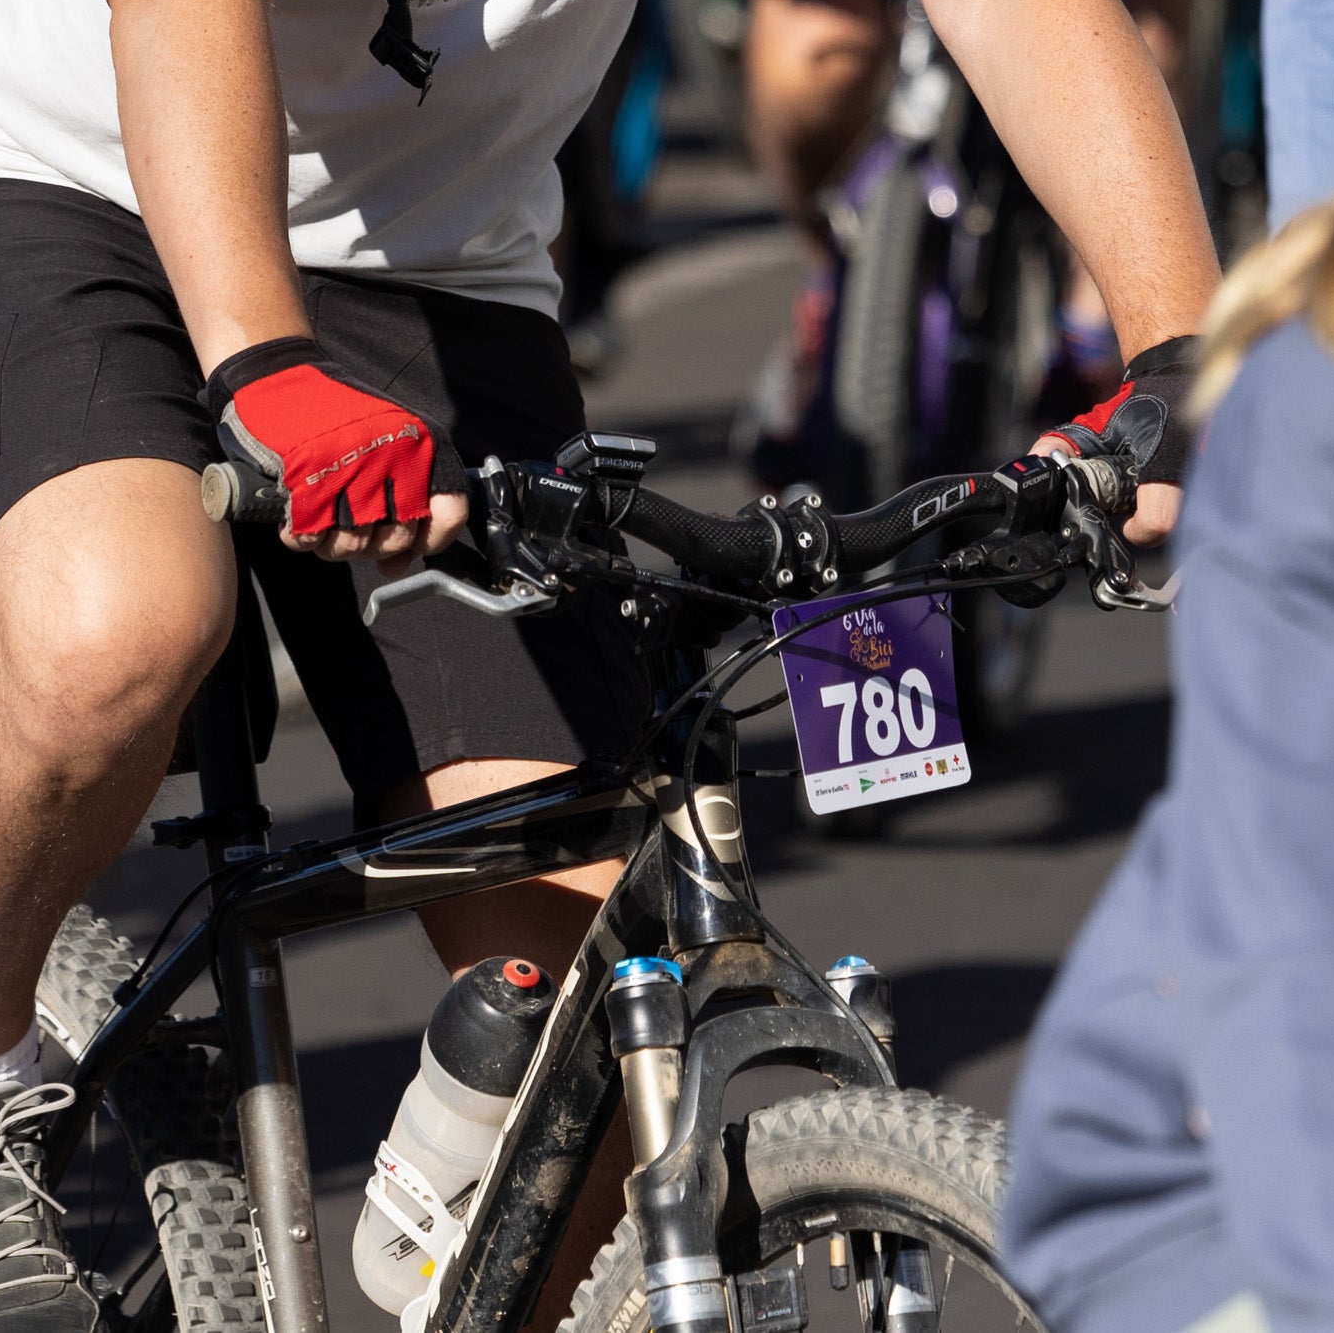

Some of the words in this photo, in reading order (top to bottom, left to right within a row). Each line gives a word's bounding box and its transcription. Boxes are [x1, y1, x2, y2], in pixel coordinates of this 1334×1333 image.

[305, 423, 419, 485] ENDURA
[601, 457, 643, 470] SIGMA
[539, 477, 583, 494] DEORE
[1022, 472, 1051, 489] DEORE
[869, 636, 894, 661] Bici
[820, 668, 937, 764] 780
